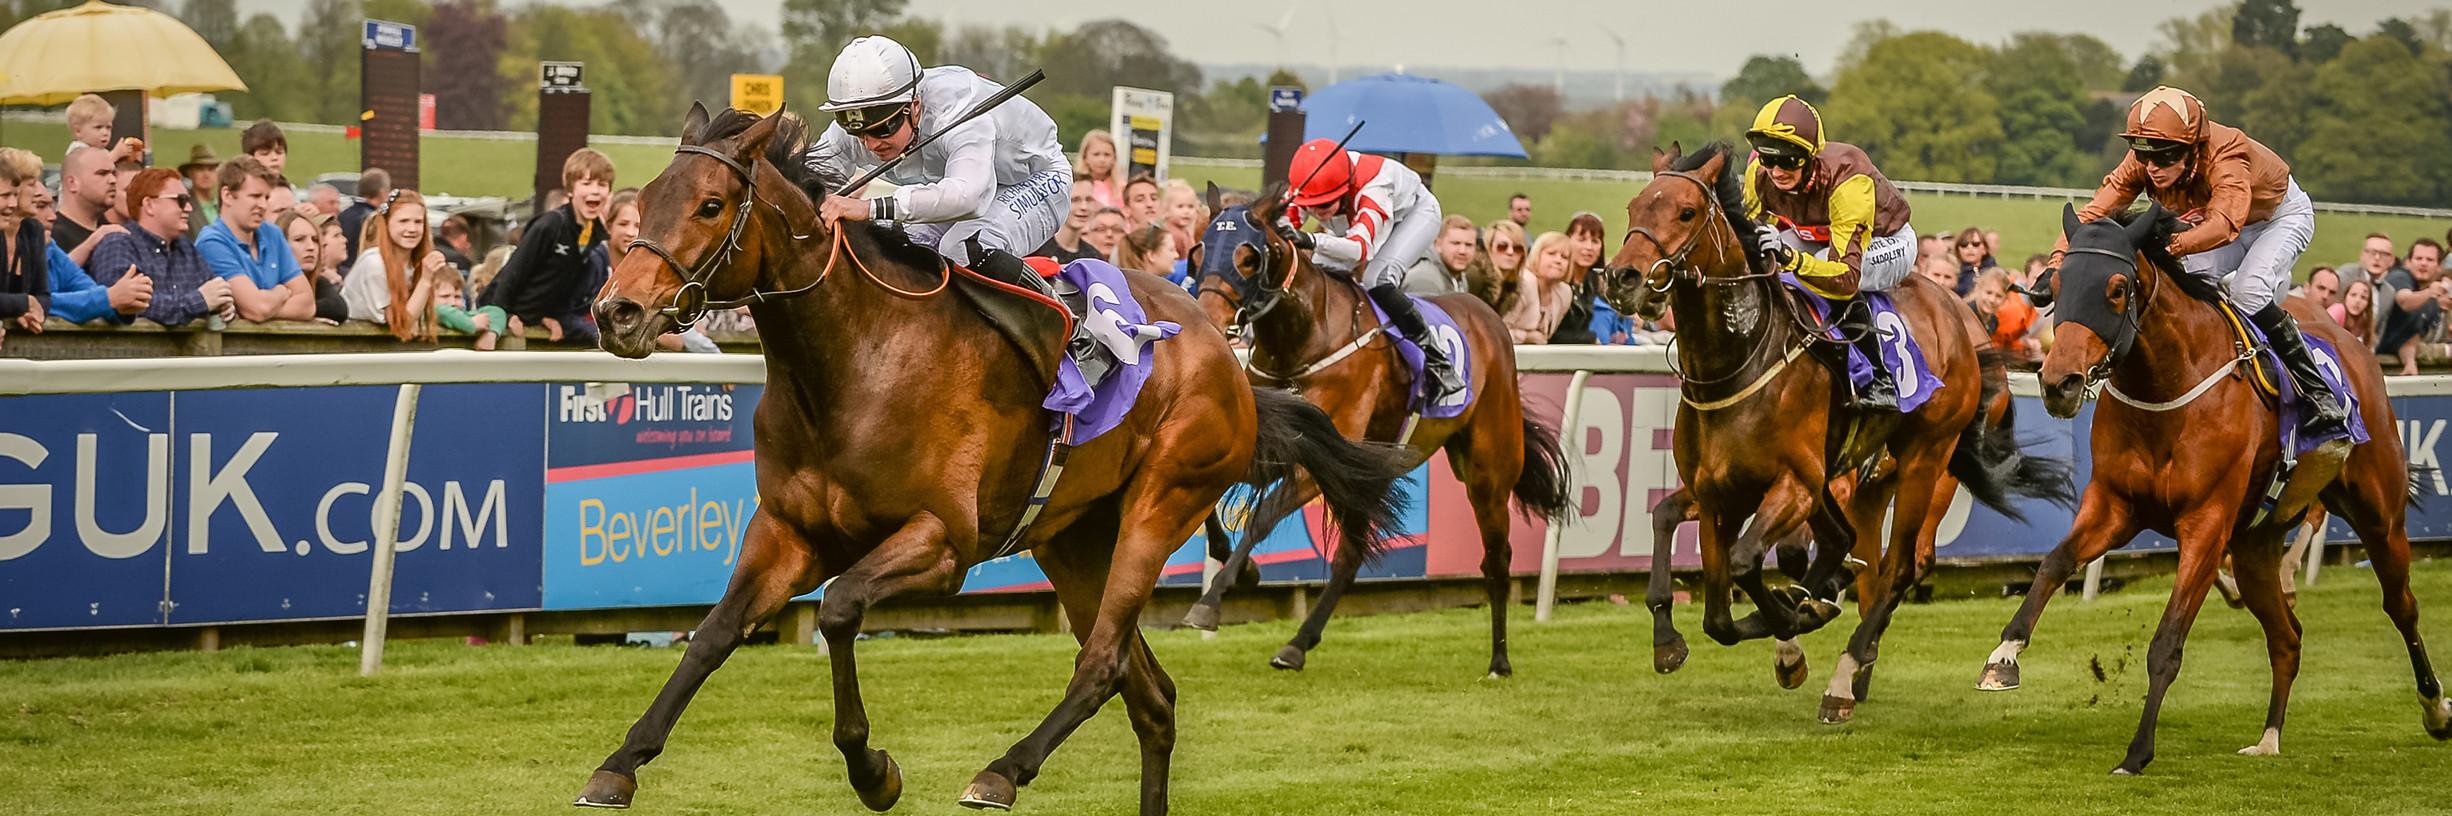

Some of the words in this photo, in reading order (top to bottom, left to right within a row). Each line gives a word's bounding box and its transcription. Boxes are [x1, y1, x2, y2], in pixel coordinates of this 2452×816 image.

[744, 82, 770, 97] CHRIS
[1877, 311, 1918, 398] 3
[635, 386, 674, 422] Hull
[677, 386, 733, 422] Trains
[579, 486, 744, 566] Beverley
